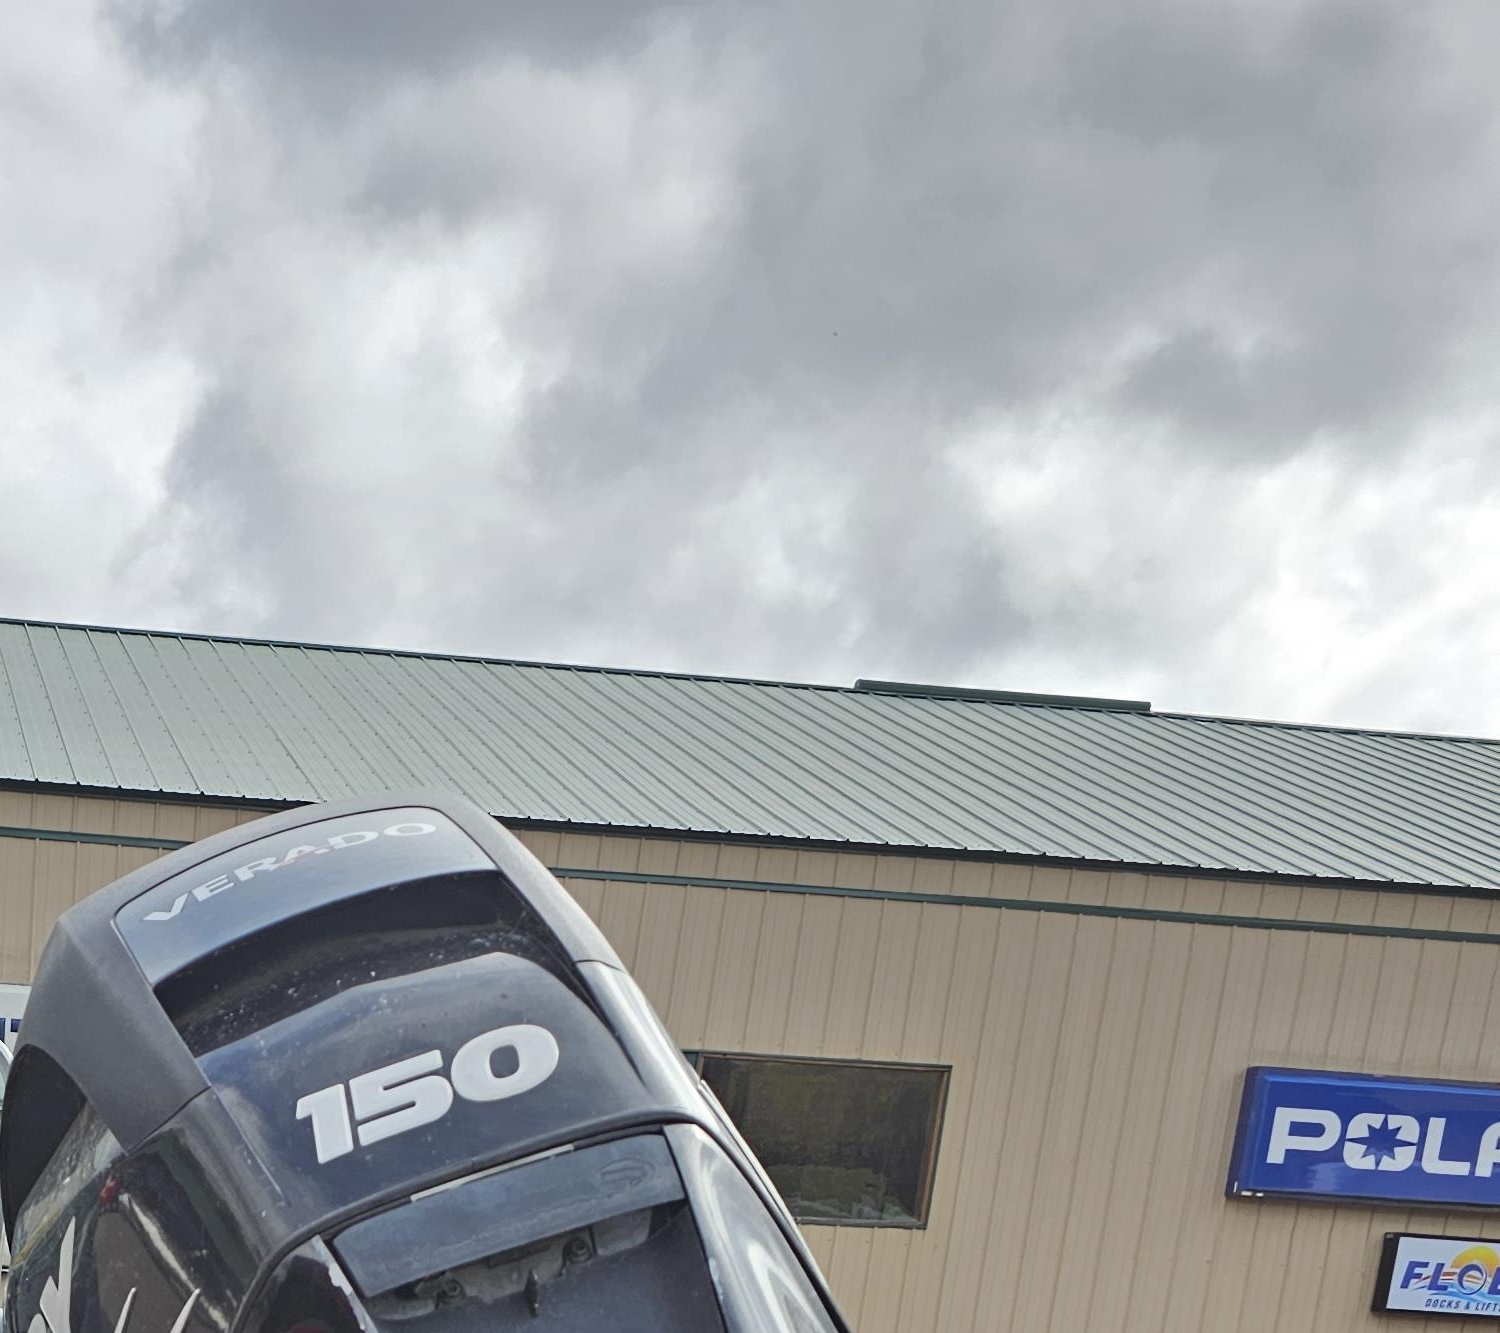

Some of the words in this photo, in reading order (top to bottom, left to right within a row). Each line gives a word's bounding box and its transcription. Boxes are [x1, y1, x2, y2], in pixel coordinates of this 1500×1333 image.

[143, 823, 437, 922] VERADO
[295, 1023, 560, 1165] 150
[1425, 1298, 1461, 1310] DOCKS
